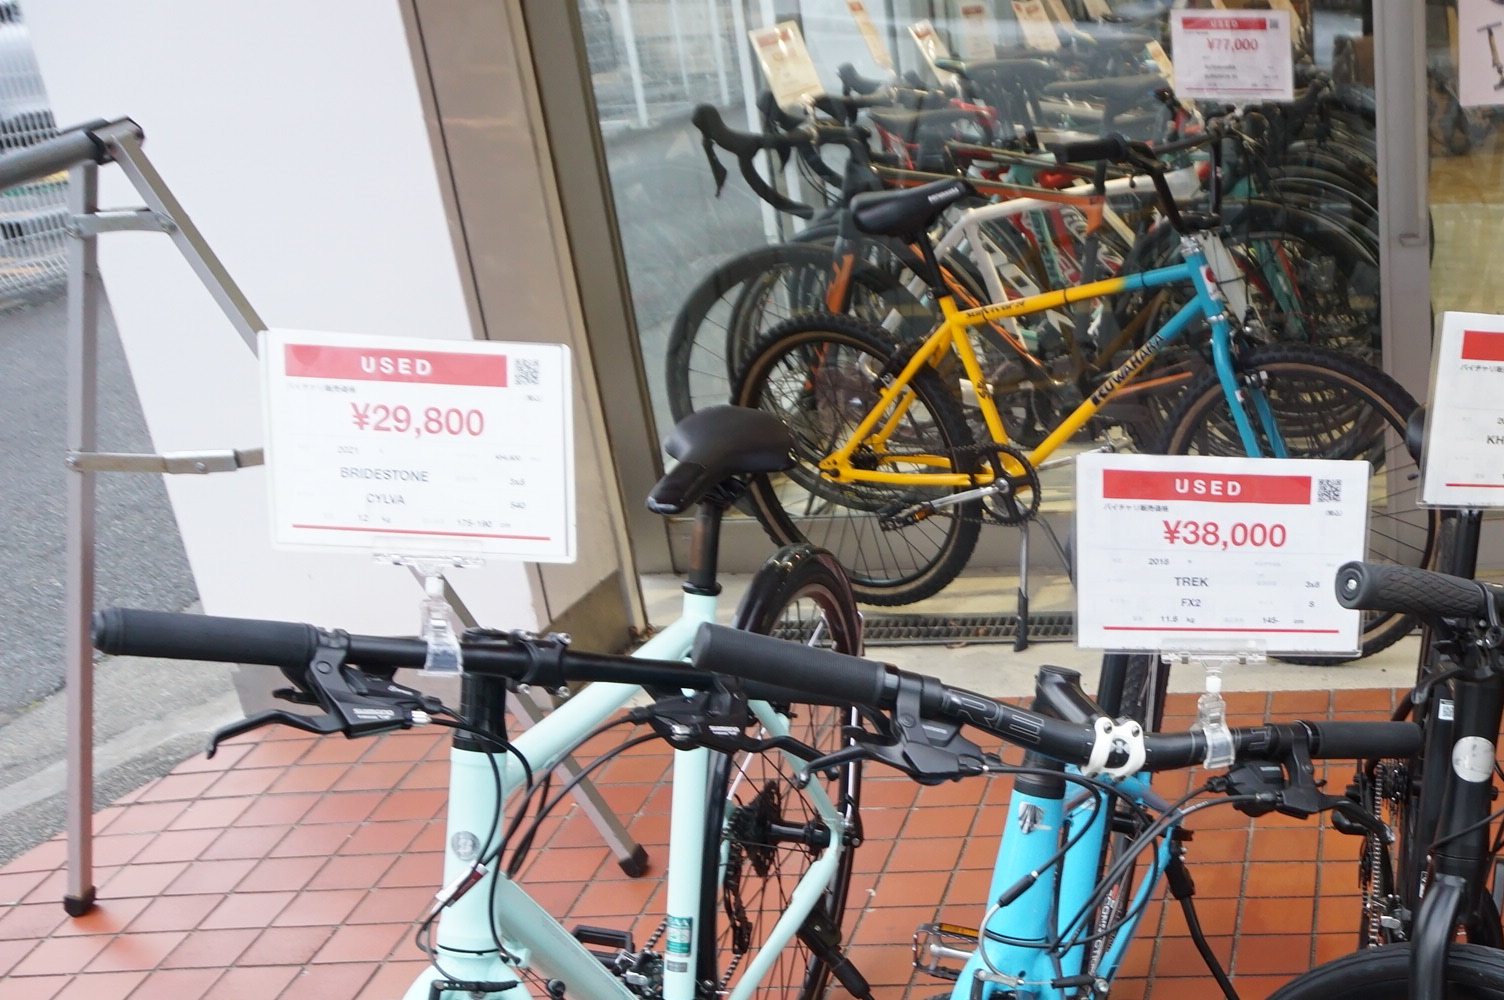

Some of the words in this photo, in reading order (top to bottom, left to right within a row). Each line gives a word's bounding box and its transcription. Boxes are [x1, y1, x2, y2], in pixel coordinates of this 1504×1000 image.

[1206, 38, 1258, 52] ¥77,000
[359, 355, 433, 376] USED
[349, 402, 485, 438] ¥29,800
[340, 466, 430, 483] BRIDESTONE
[1174, 477, 1243, 497] USED
[366, 492, 406, 505] CYLVA
[1162, 519, 1288, 551] ¥38,000
[1174, 576, 1210, 588] TREK
[1181, 598, 1202, 608] FX2
